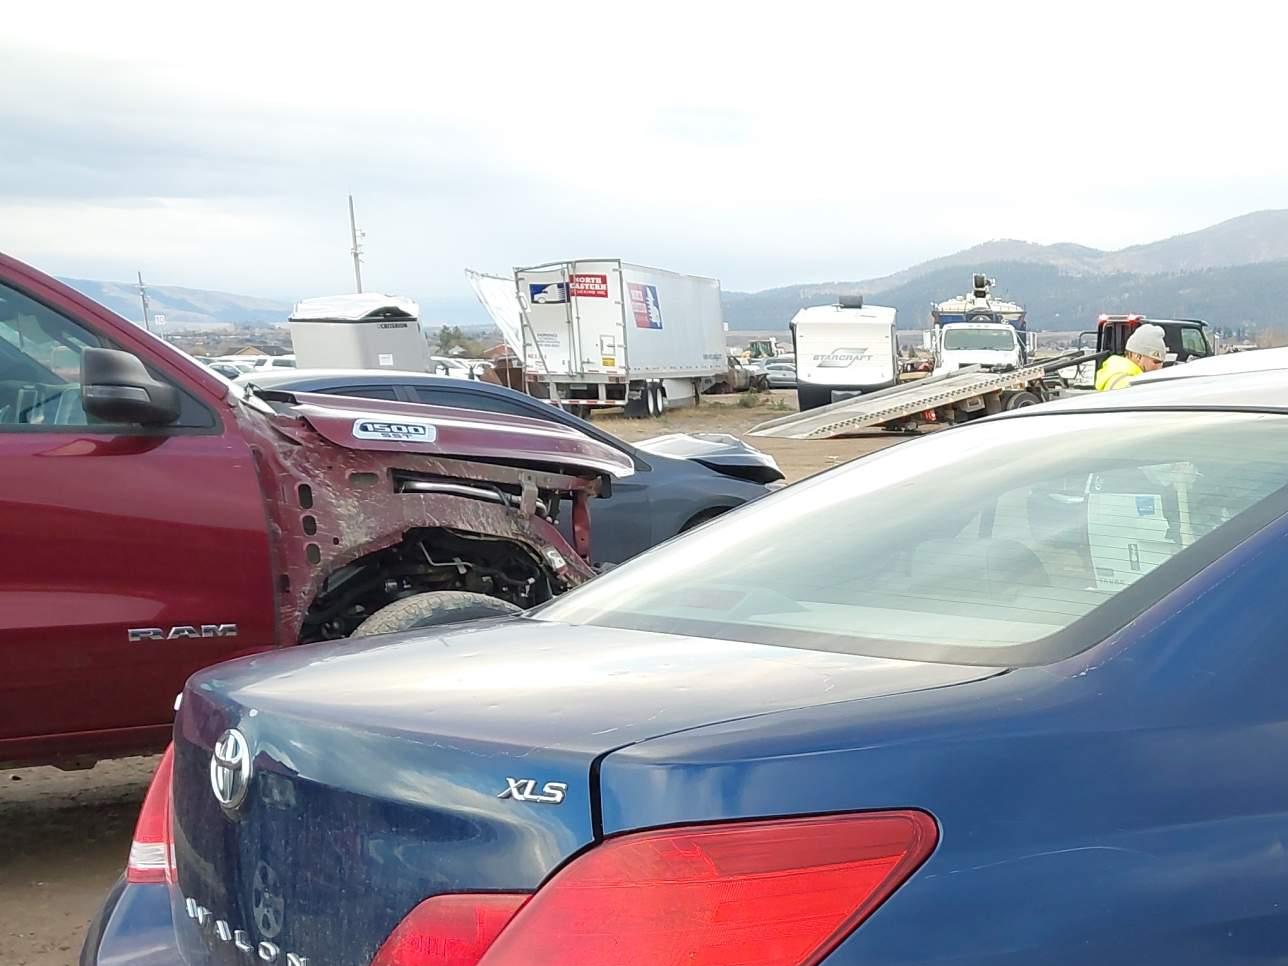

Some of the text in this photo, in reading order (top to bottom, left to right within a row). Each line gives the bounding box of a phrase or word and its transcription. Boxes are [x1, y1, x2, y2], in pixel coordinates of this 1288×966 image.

[363, 423, 425, 434] 1500
[127, 623, 238, 642] RAM
[497, 777, 568, 804] XLS
